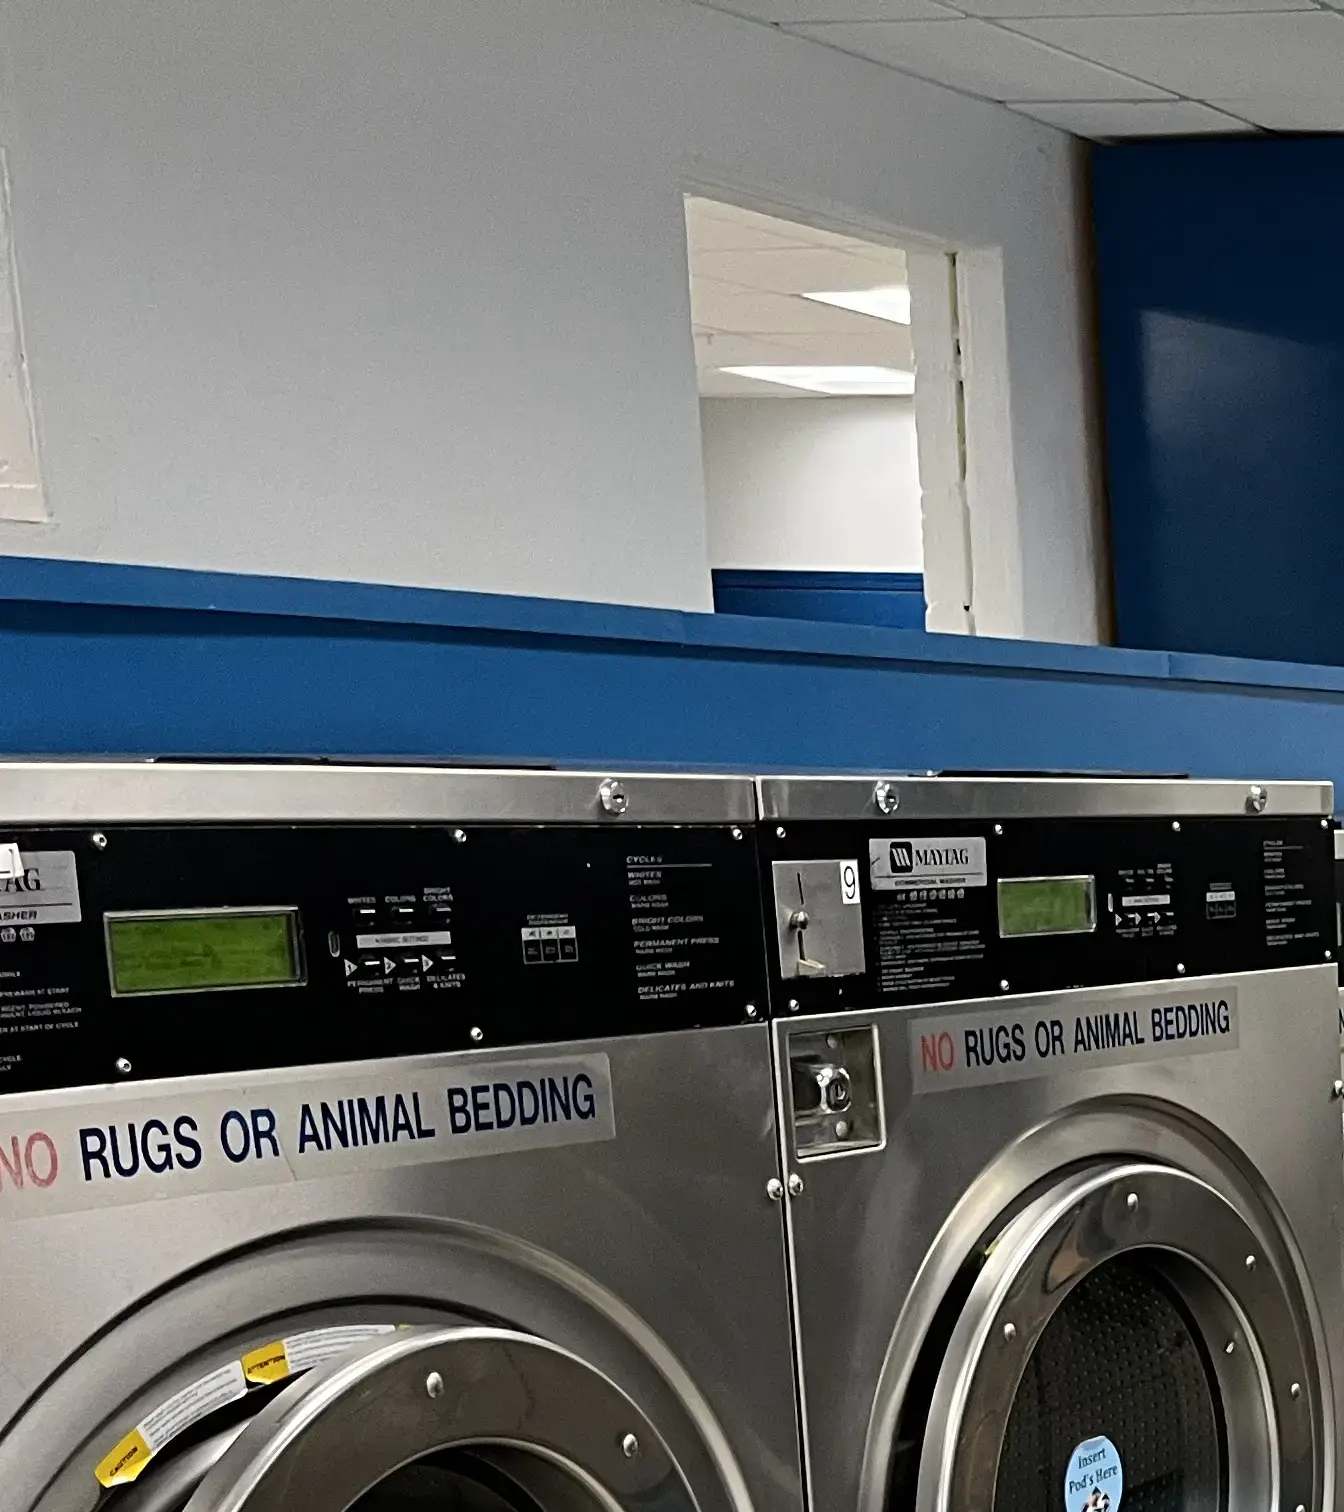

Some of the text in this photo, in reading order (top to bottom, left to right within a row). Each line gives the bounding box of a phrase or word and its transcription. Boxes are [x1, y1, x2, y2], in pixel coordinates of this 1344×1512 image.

[915, 848, 969, 867] MAYTAG
[844, 865, 856, 900] 9
[920, 999, 1231, 1073] NO RUGS OR ANIMAL BEDDING
[79, 1115, 203, 1182] RUGS
[220, 1108, 279, 1164] OR
[298, 1092, 435, 1154] ANIMAL
[446, 1073, 597, 1135] BEDDING
[1078, 1447, 1107, 1470] Insert
[1068, 1465, 1119, 1495] Pod's Here
